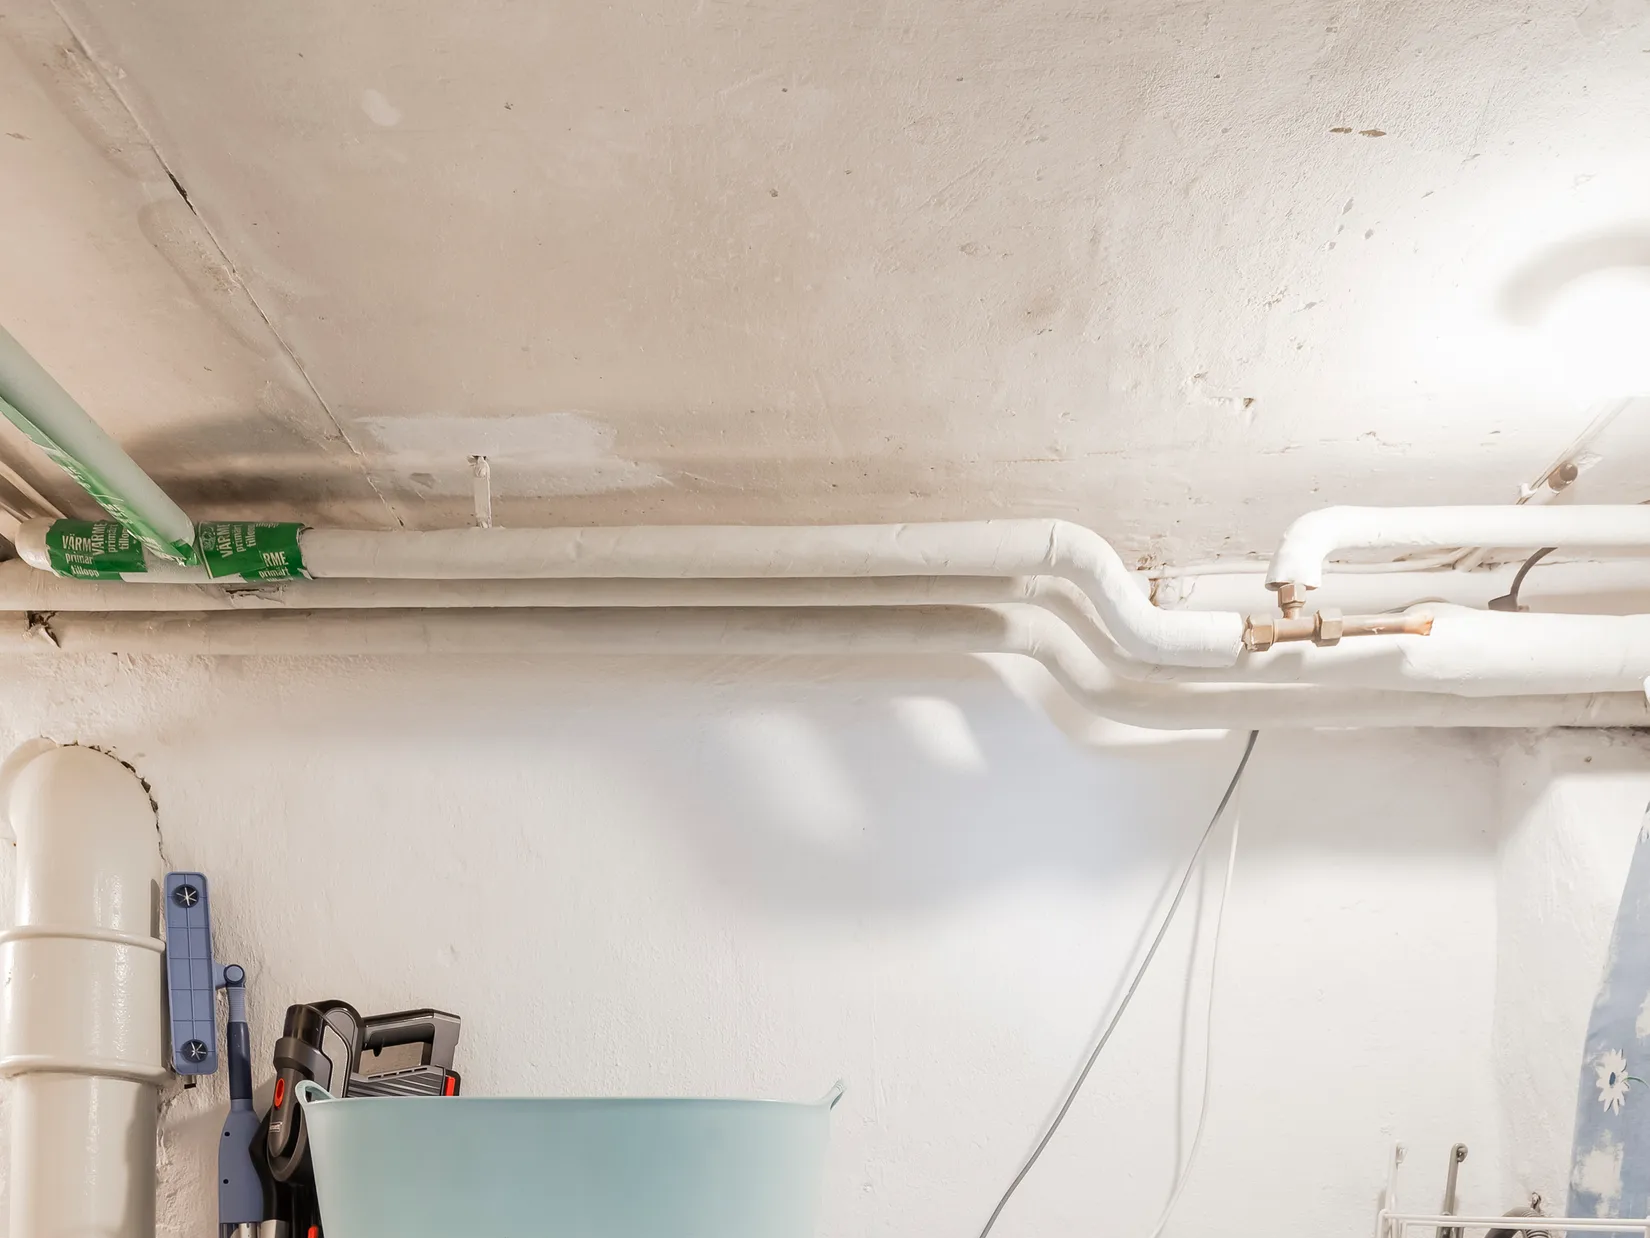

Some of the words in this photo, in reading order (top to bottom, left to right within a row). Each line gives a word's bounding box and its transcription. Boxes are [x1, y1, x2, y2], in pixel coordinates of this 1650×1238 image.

[62, 533, 91, 552] VÄRM
[65, 552, 93, 564] primär
[263, 551, 289, 567] RME
